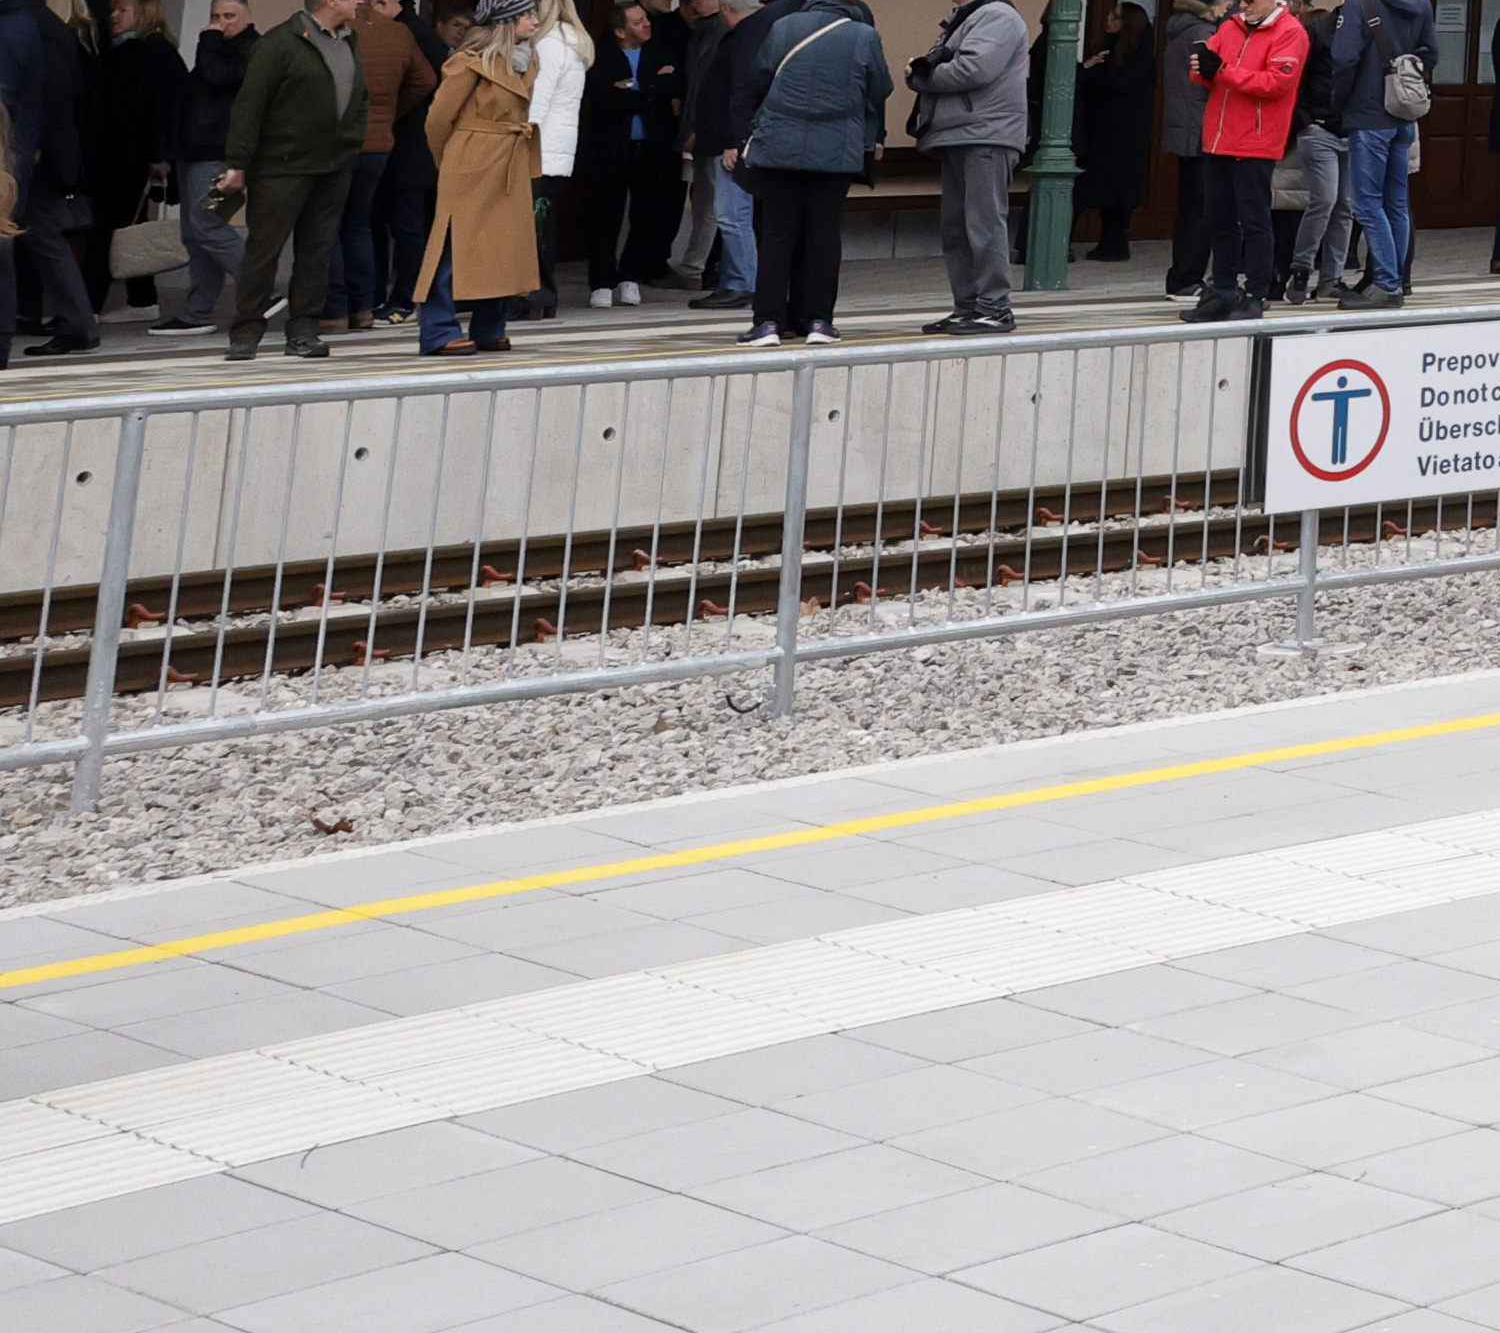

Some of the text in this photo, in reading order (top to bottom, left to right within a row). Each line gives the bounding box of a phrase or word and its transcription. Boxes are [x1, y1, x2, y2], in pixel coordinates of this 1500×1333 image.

[1420, 386, 1450, 408] Do
[1453, 383, 1488, 405] not
[1417, 450, 1495, 476] Vietato
